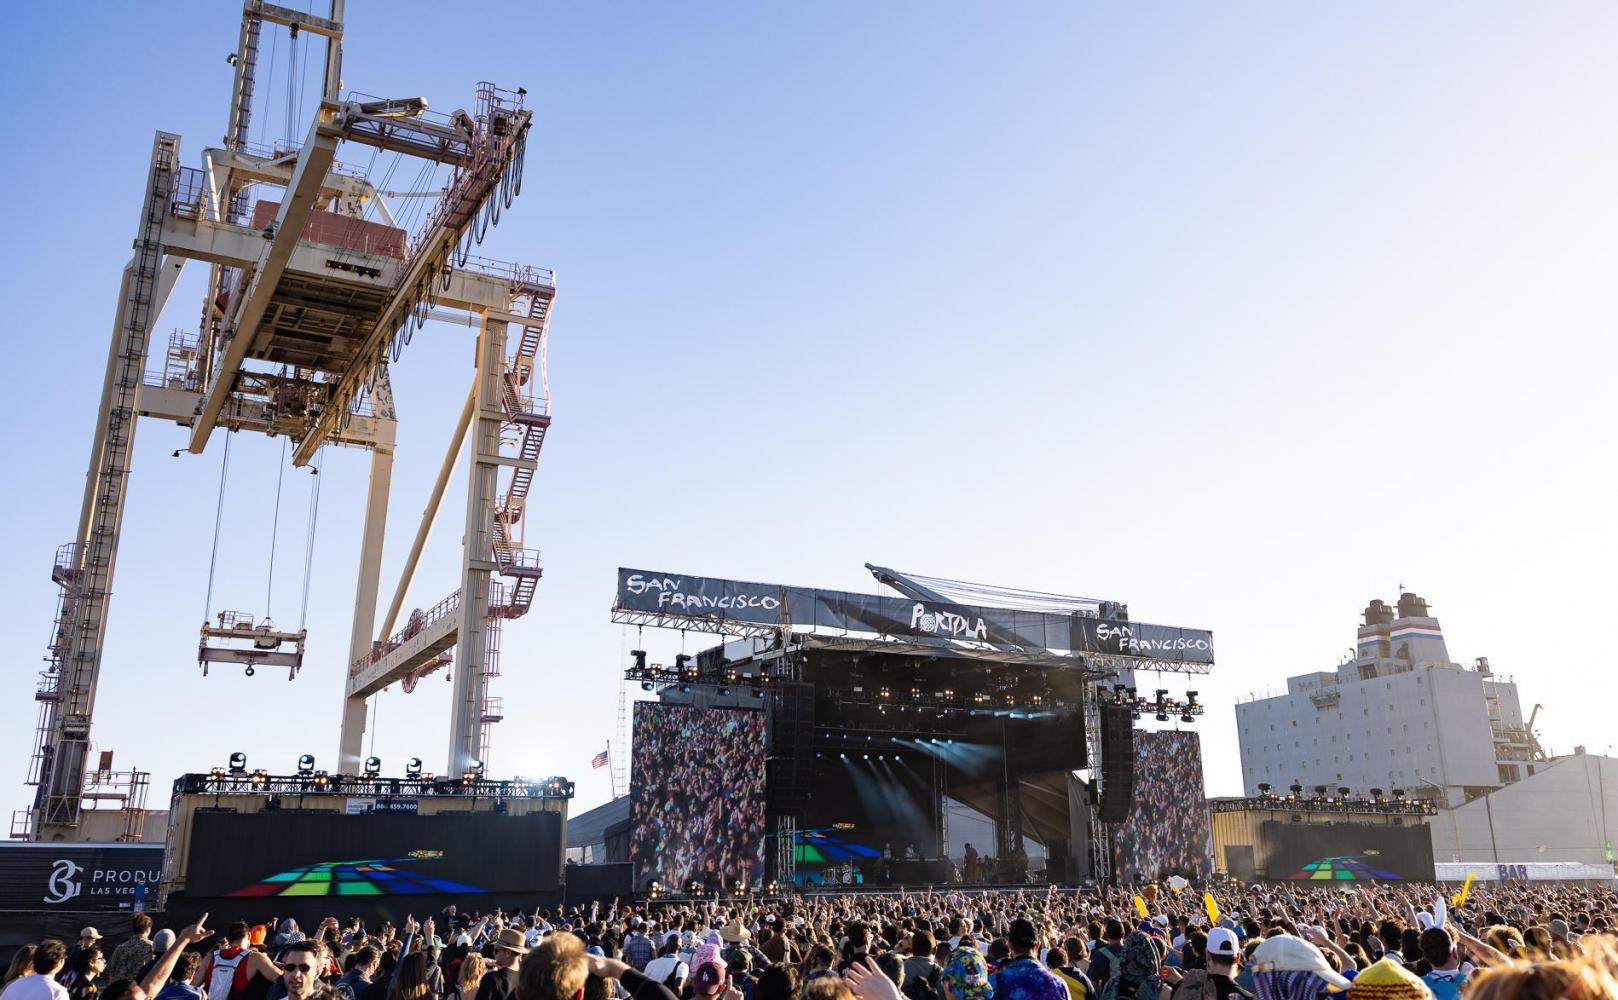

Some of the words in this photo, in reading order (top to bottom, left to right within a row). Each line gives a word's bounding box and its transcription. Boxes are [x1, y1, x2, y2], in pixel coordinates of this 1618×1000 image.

[626, 574, 681, 595] SAN
[658, 592, 780, 610] FRANCISCO
[910, 602, 988, 640] PORTOLA
[1096, 623, 1134, 640] SAN
[1119, 637, 1209, 652] FRANCISCO
[1497, 864, 1528, 881] BAR
[90, 887, 110, 895] LAS
[116, 887, 149, 895] VEGS
